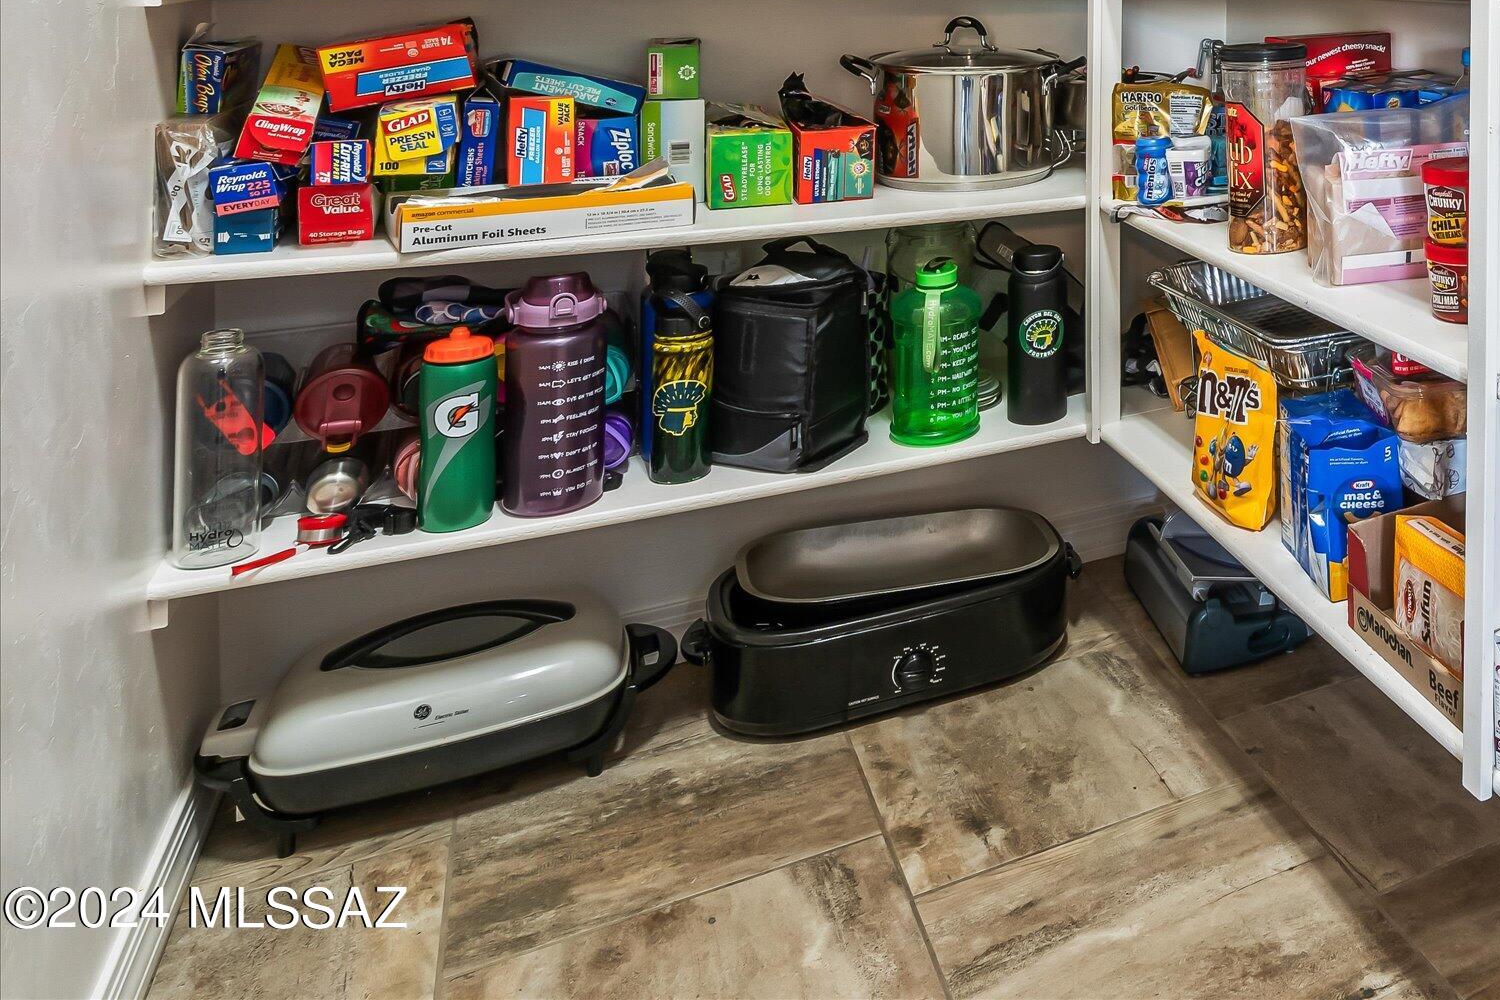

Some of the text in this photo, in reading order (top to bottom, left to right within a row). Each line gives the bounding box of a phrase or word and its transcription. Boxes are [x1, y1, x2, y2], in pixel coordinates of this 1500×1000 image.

[329, 49, 362, 61] PACK
[329, 56, 364, 68] MEGA
[386, 80, 425, 96] Hefty
[1121, 92, 1163, 104] HARIBO
[255, 119, 306, 136] ClingWrap
[388, 112, 429, 132] GLAD
[389, 130, 436, 146] PRESS'N
[577, 122, 585, 146] SNACK
[400, 141, 430, 153] SEAL
[516, 128, 527, 158] Hefty
[610, 128, 634, 171] Ziploc
[379, 162, 399, 171] 100
[217, 170, 268, 184] Reynolds
[216, 180, 271, 193] Wrap 225
[722, 174, 737, 201] GLAD
[223, 199, 271, 212] EVERYDAY
[311, 193, 360, 207] Great
[1428, 193, 1464, 211] CHUNKY
[412, 224, 453, 235] Pre-Cut
[1430, 218, 1462, 233] CHILI
[319, 230, 346, 238] Storage
[412, 226, 548, 247] Aluminum Foil Sheets
[1429, 668, 1459, 710] Beef
